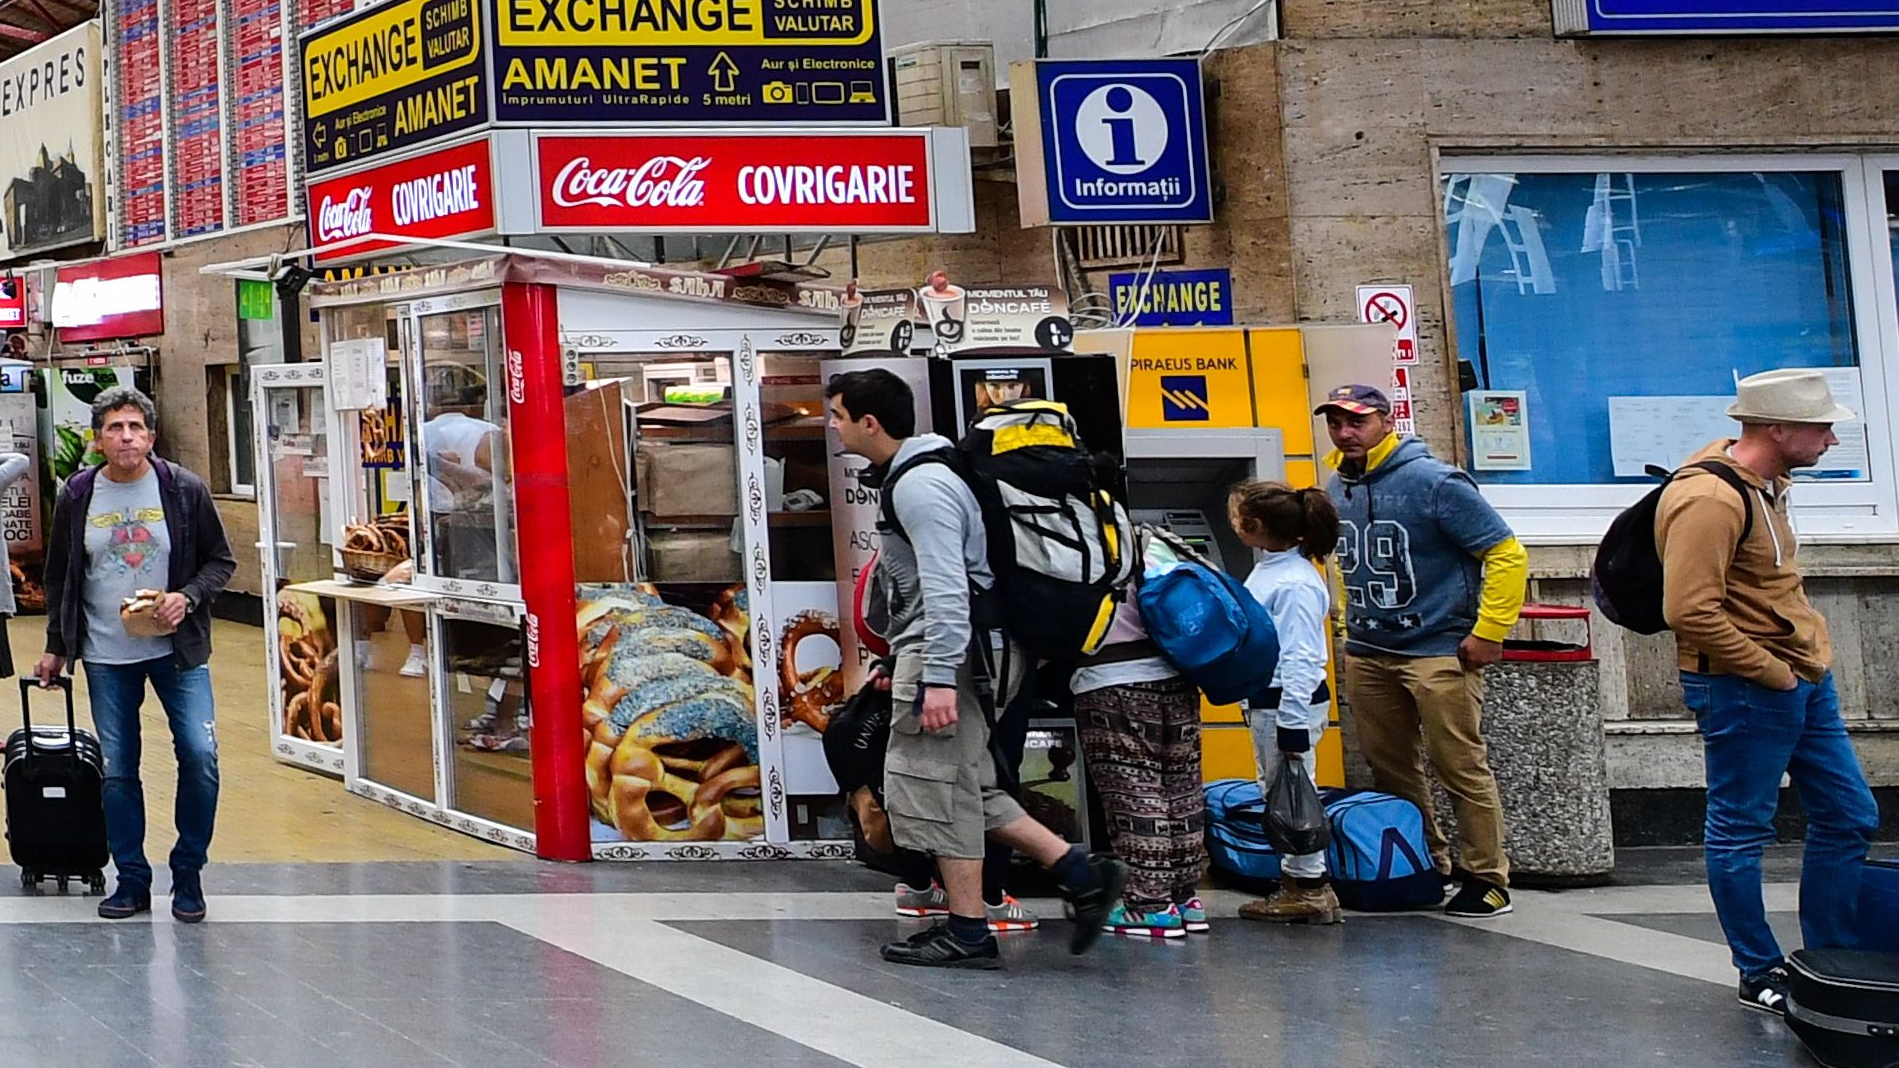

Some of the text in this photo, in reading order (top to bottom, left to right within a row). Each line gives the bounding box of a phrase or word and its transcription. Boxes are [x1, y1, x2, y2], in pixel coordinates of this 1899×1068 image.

[775, 14, 854, 32] VALUTAR
[427, 27, 470, 59] VALUTAR
[309, 18, 418, 101] EXCHANGE
[503, 57, 687, 90] AMANET
[761, 59, 784, 70] Aur
[803, 58, 875, 70] Electronice
[2, 47, 85, 117] EXPRES
[394, 75, 479, 138] AMANET
[603, 93, 690, 106] UltraRapide
[703, 94, 712, 105] 5
[715, 93, 751, 105] metri
[392, 164, 479, 226] COVRIGARIE
[552, 156, 915, 207] Coca-Cola COVRIGARIE
[1075, 177, 1180, 201] Informații
[967, 287, 1048, 298] MOMENTUL TĂU
[1116, 282, 1221, 314] EXCHANGE
[1131, 357, 1237, 371] PIRAEUS BANK
